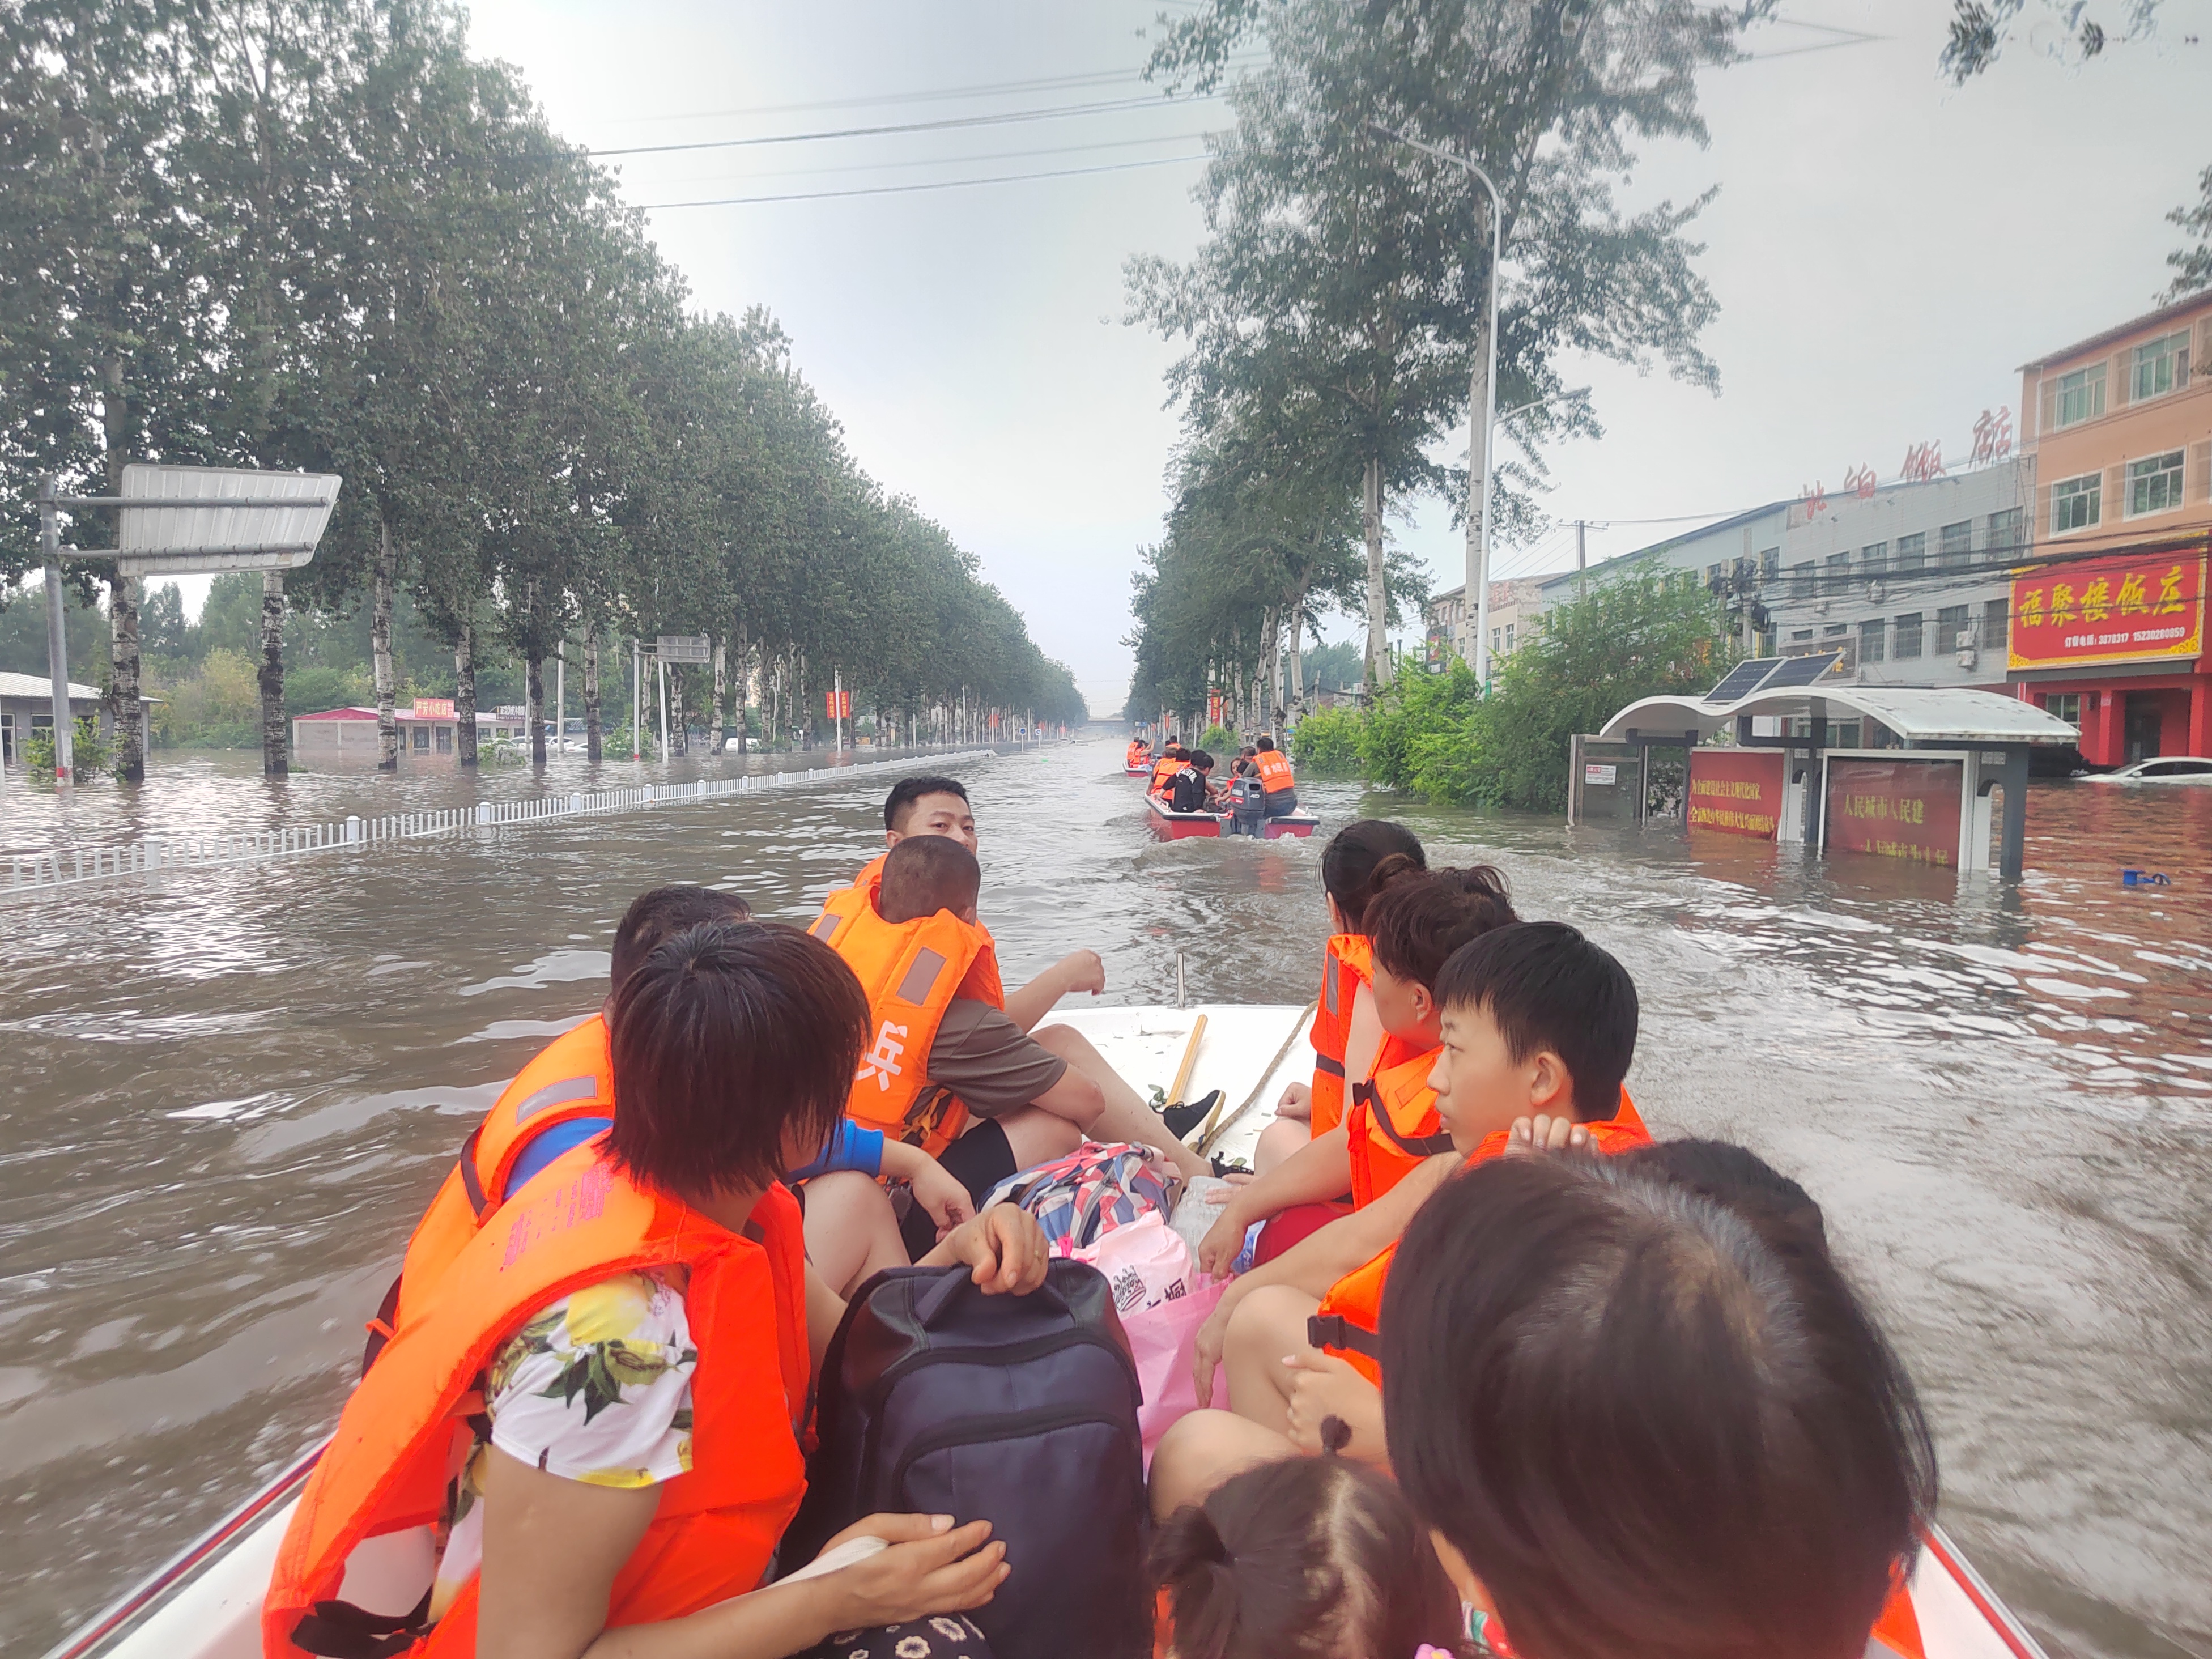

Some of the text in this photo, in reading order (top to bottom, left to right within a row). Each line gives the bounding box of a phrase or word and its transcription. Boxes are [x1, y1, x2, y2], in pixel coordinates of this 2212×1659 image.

[2019, 565, 2185, 628] 福聚楼饭庄
